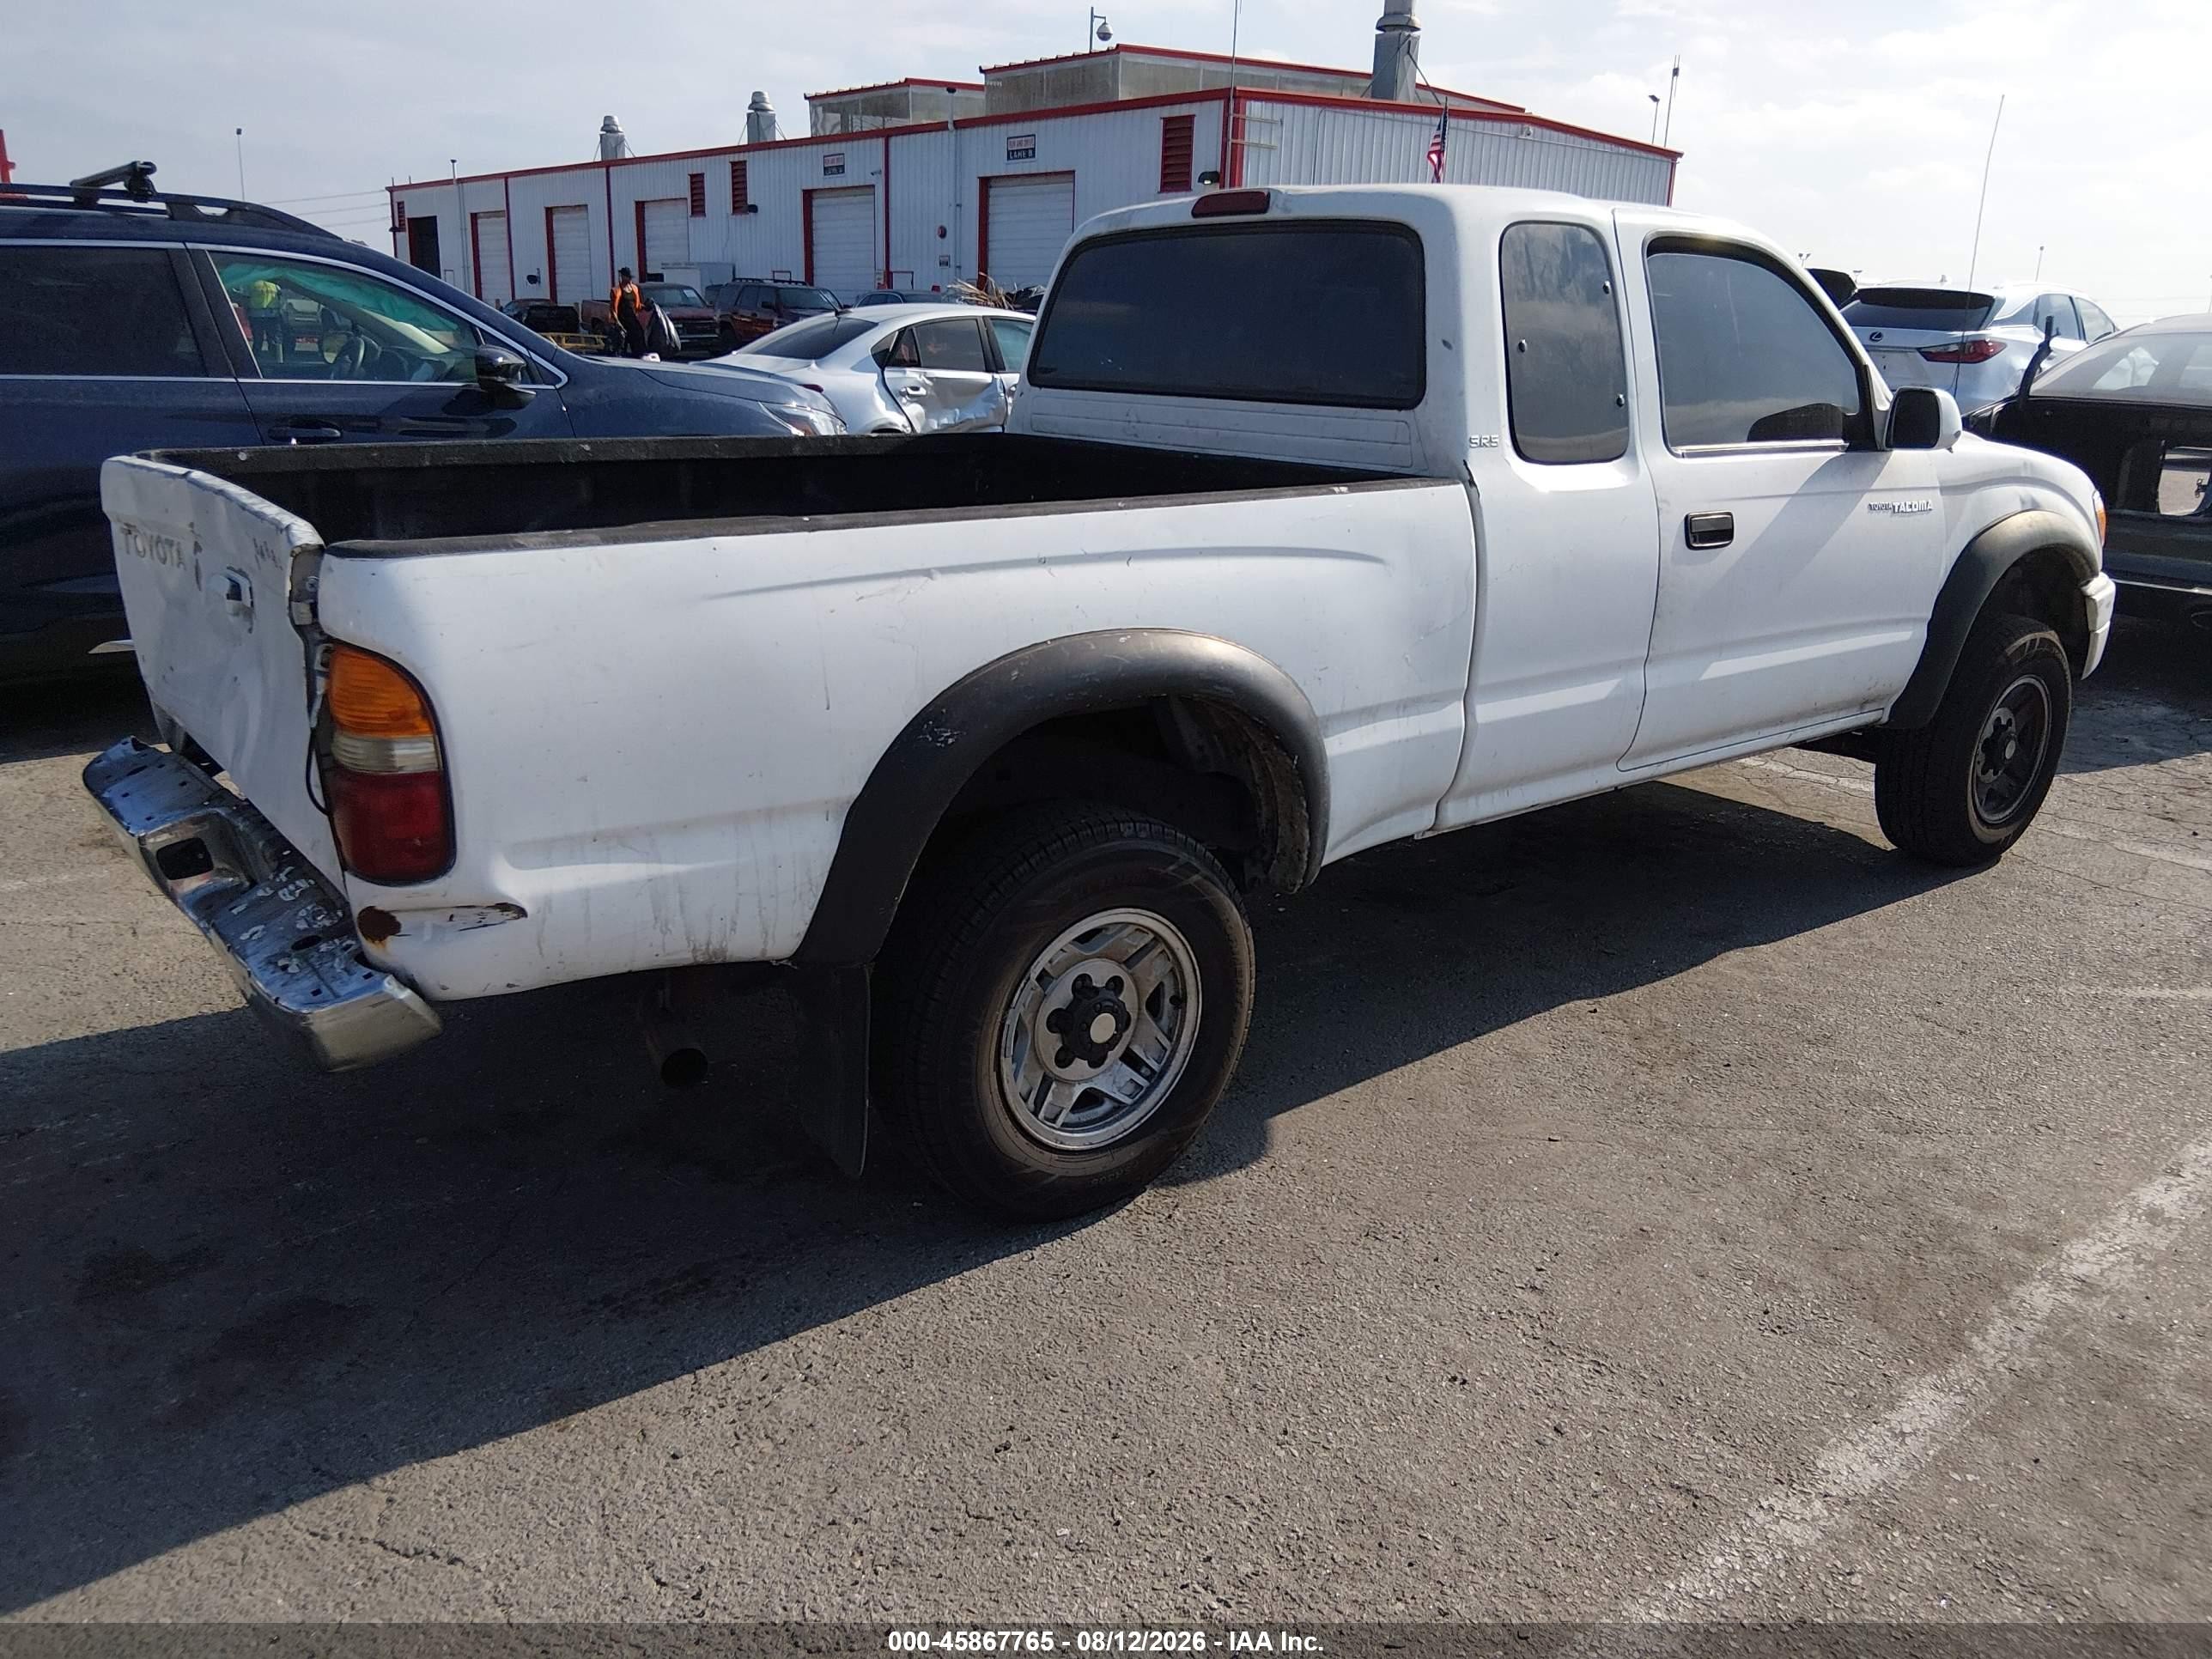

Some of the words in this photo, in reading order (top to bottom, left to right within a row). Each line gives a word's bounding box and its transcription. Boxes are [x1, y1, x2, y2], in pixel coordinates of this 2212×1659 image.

[1009, 149, 1026, 160] LANE
[1869, 501, 1893, 512] TOYOTA
[1892, 499, 1933, 514] TACOMA
[121, 522, 186, 570] TOYOTA
